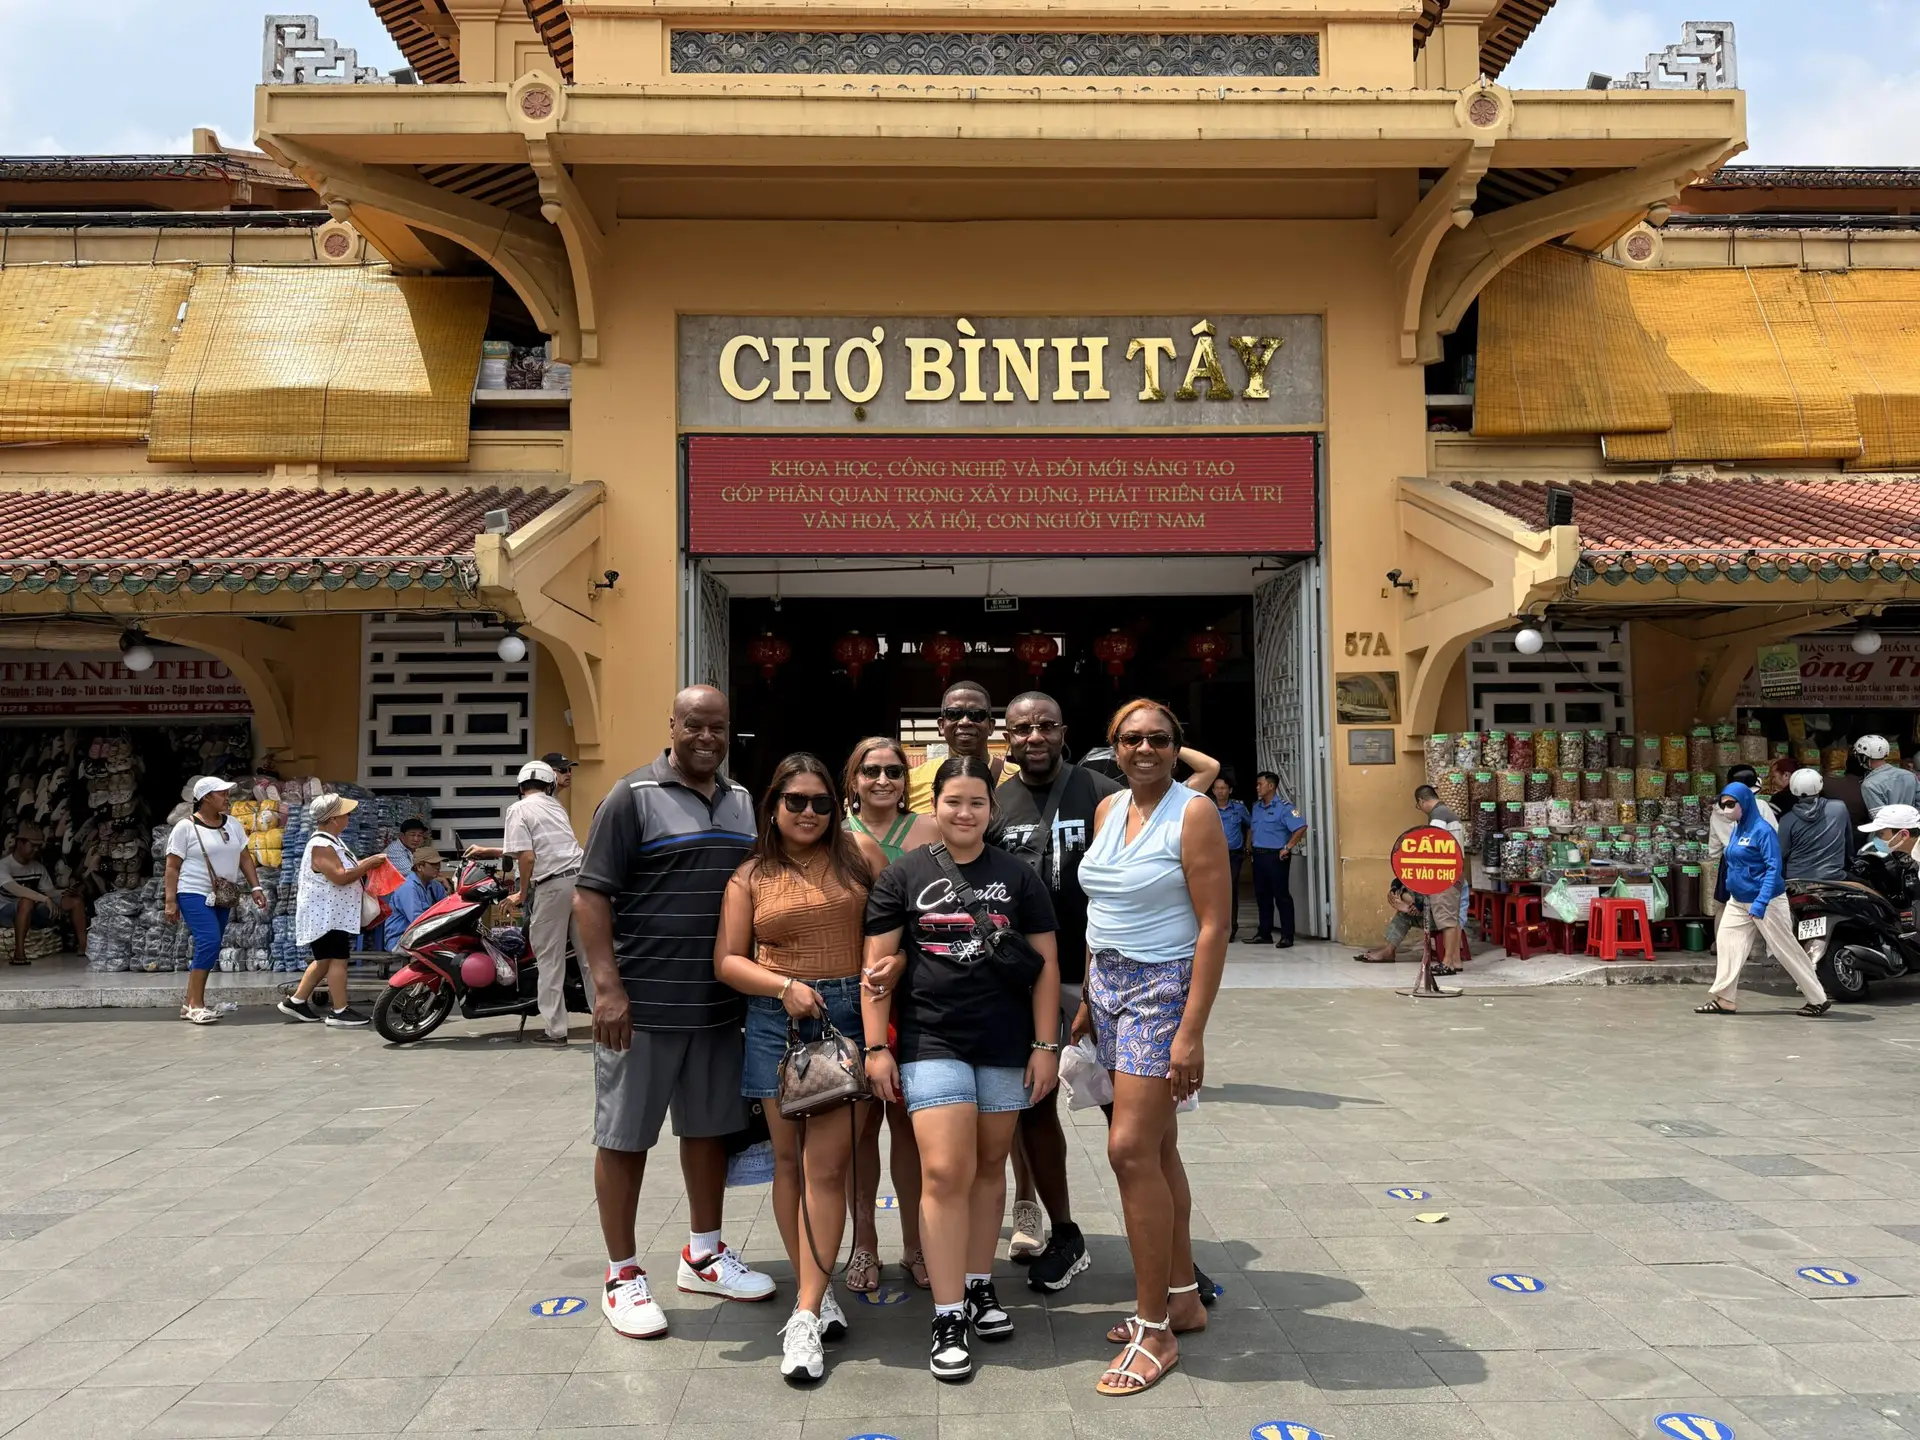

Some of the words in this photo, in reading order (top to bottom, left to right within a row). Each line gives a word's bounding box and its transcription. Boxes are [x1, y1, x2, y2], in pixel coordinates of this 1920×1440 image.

[718, 320, 885, 422] CHỢ
[904, 317, 1110, 402] BÌNH
[1126, 319, 1286, 401] TÂY
[769, 460, 830, 477] KHOA
[834, 460, 882, 480] HỌC,
[887, 456, 946, 477] CÔNG
[952, 458, 1007, 480] NGHỆ
[1012, 457, 1042, 477] VÀ
[1088, 457, 1128, 477] MỚI
[1133, 457, 1188, 477] SÁNG
[1193, 460, 1236, 480] TẠO
[720, 483, 763, 503] GÓP
[767, 483, 824, 503] PHẦN
[828, 486, 889, 507] QUAN
[894, 486, 965, 506] TRỌNG
[968, 483, 1014, 503] XÂY
[1018, 485, 1083, 506] DỰNG,
[1087, 482, 1141, 503] PHÁT
[1209, 482, 1247, 503] GIÁ
[1251, 485, 1285, 504] TRỊ
[802, 509, 847, 529] VĂN
[852, 509, 901, 532] HOÁ,
[906, 509, 936, 529] XÃ
[941, 508, 982, 532] HỘI,
[987, 512, 1031, 529] CON
[1035, 509, 1101, 529] NGƯỜI
[1107, 510, 1153, 531] VIỆT
[1156, 512, 1207, 529] NAM
[1344, 631, 1391, 657] 57A
[0, 661, 137, 680] THANH
[1400, 833, 1456, 854] CẤM
[1401, 868, 1414, 881] XE
[1416, 865, 1437, 881] VÀO
[1439, 867, 1456, 884] CHỢ
[916, 877, 1012, 911] Coette
